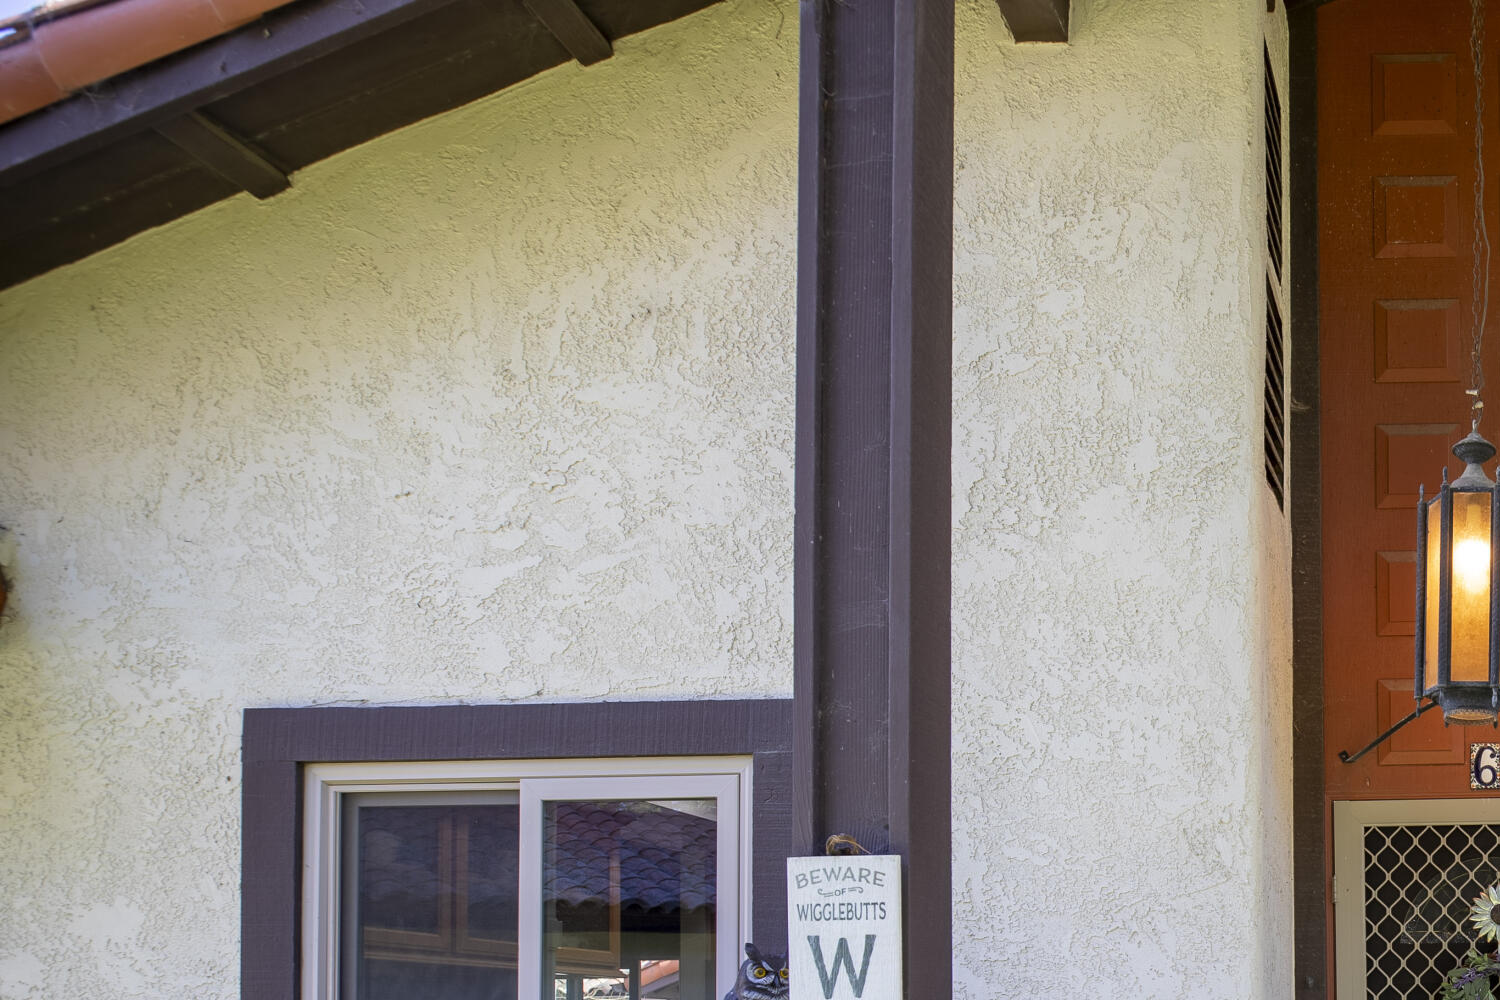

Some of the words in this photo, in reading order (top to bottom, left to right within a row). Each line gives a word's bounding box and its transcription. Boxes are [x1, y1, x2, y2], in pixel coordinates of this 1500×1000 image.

[1474, 746, 1497, 786] 6
[795, 866, 886, 889] BEWARE
[834, 887, 847, 896] OF
[796, 902, 887, 922] WIGGLEBUTTS
